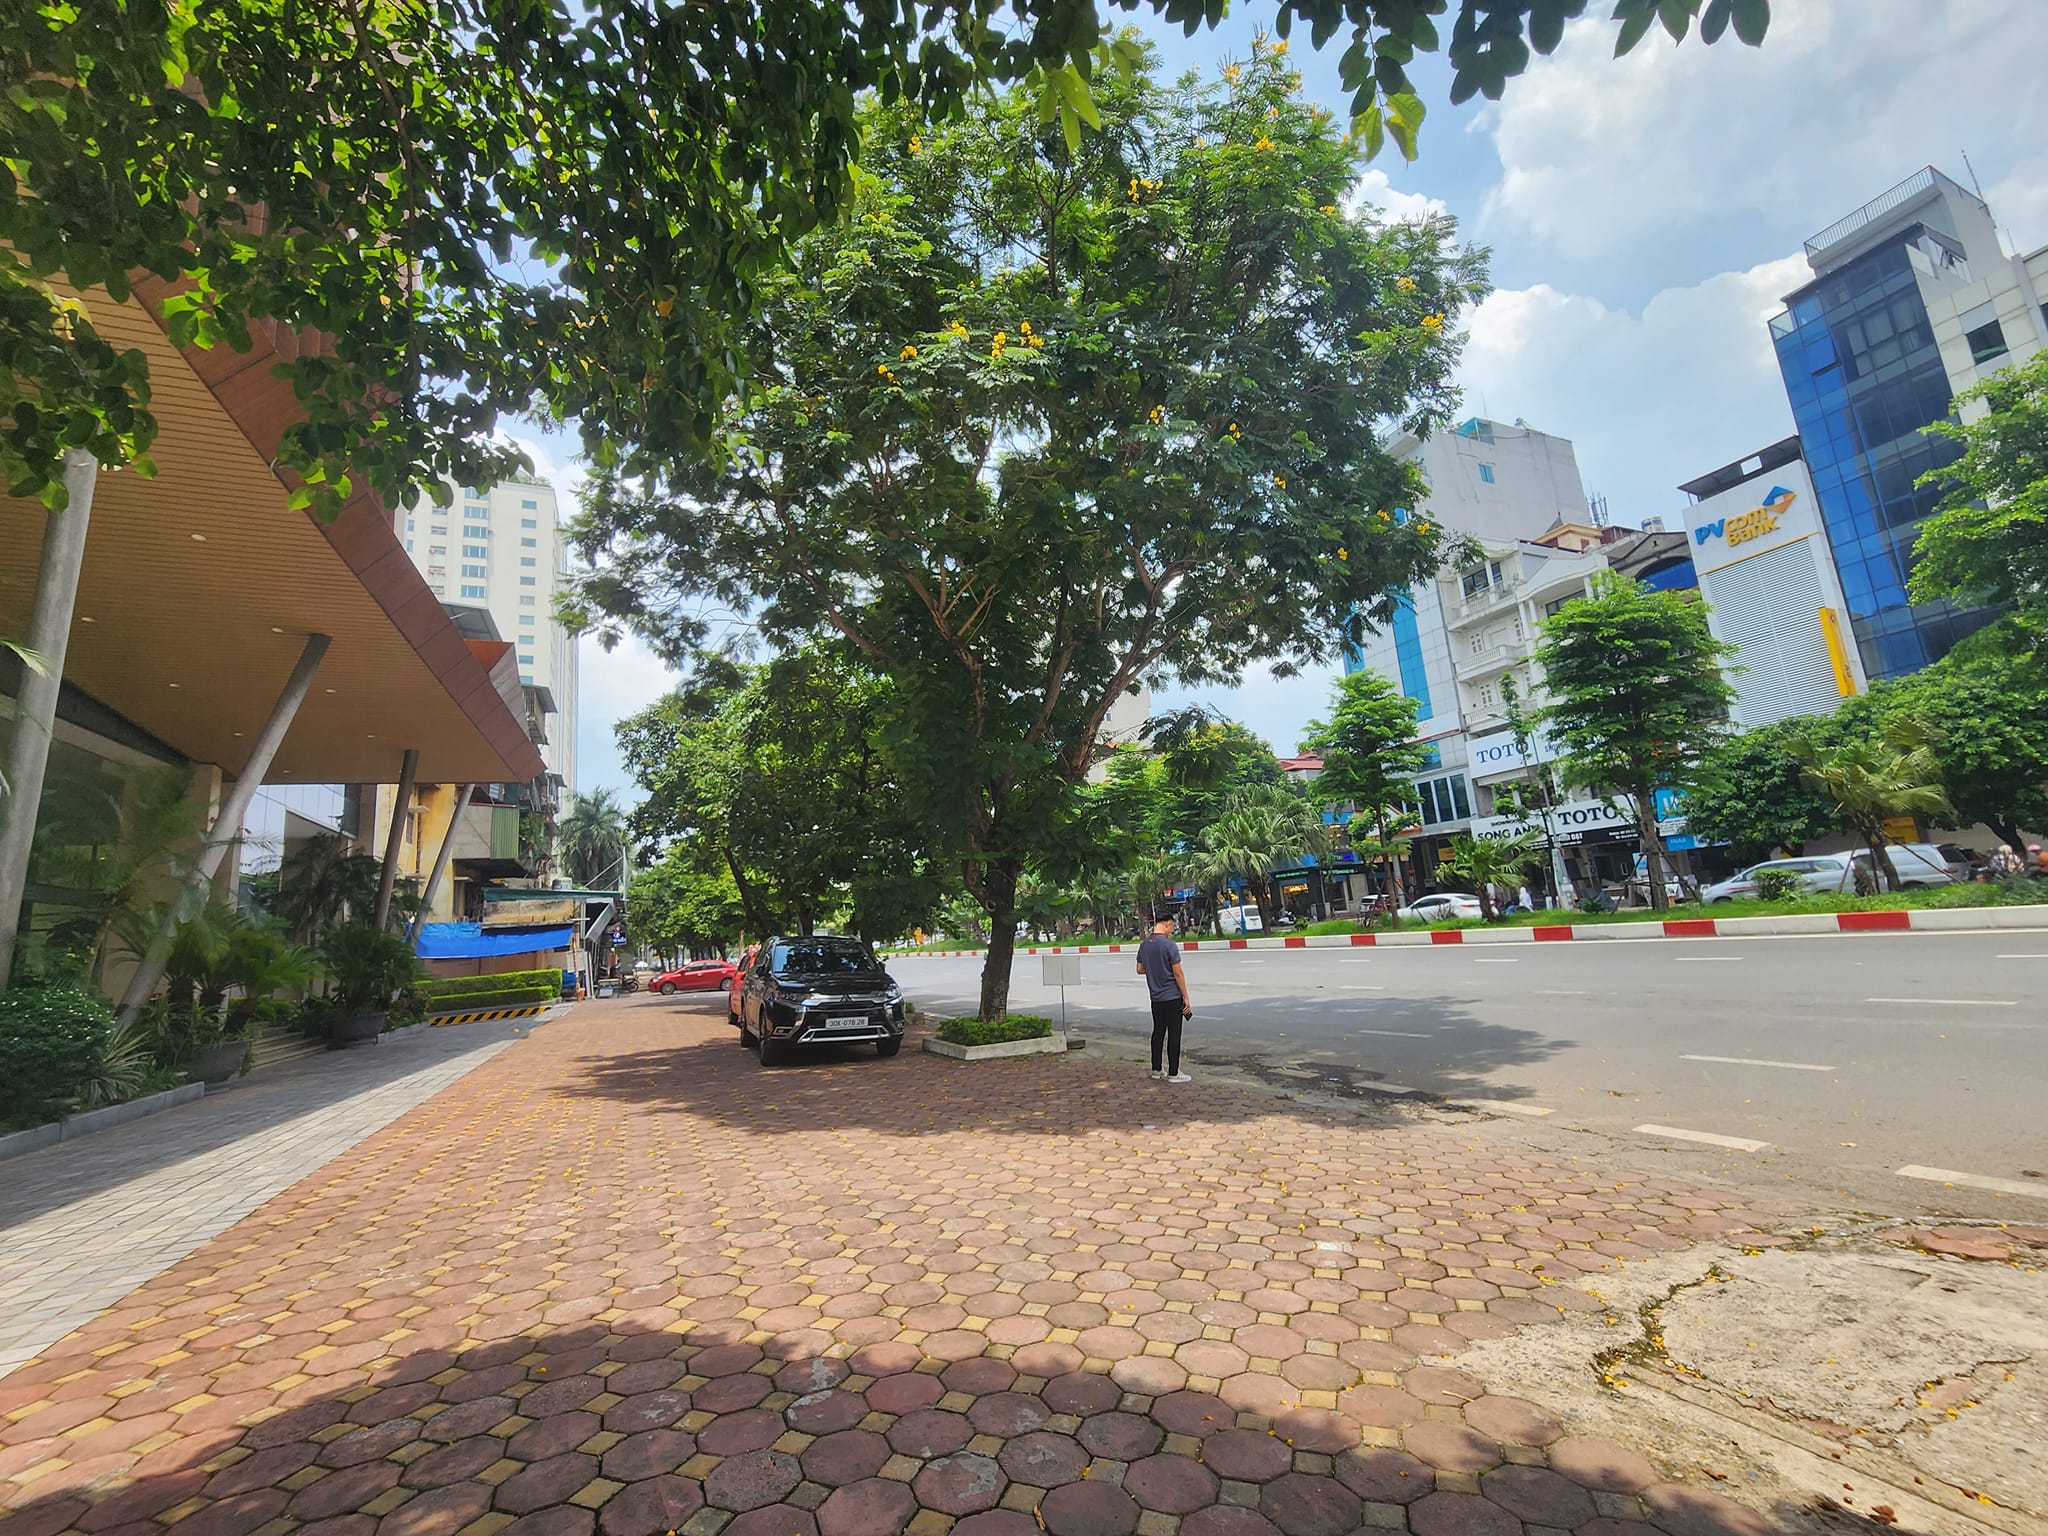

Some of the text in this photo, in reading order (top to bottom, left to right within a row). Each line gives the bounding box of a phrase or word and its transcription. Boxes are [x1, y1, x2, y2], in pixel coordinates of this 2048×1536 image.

[1727, 516, 1780, 547] Bank
[1477, 741, 1528, 763] TOTO
[1557, 805, 1618, 825] TOTO
[1477, 828, 1511, 841] SONG
